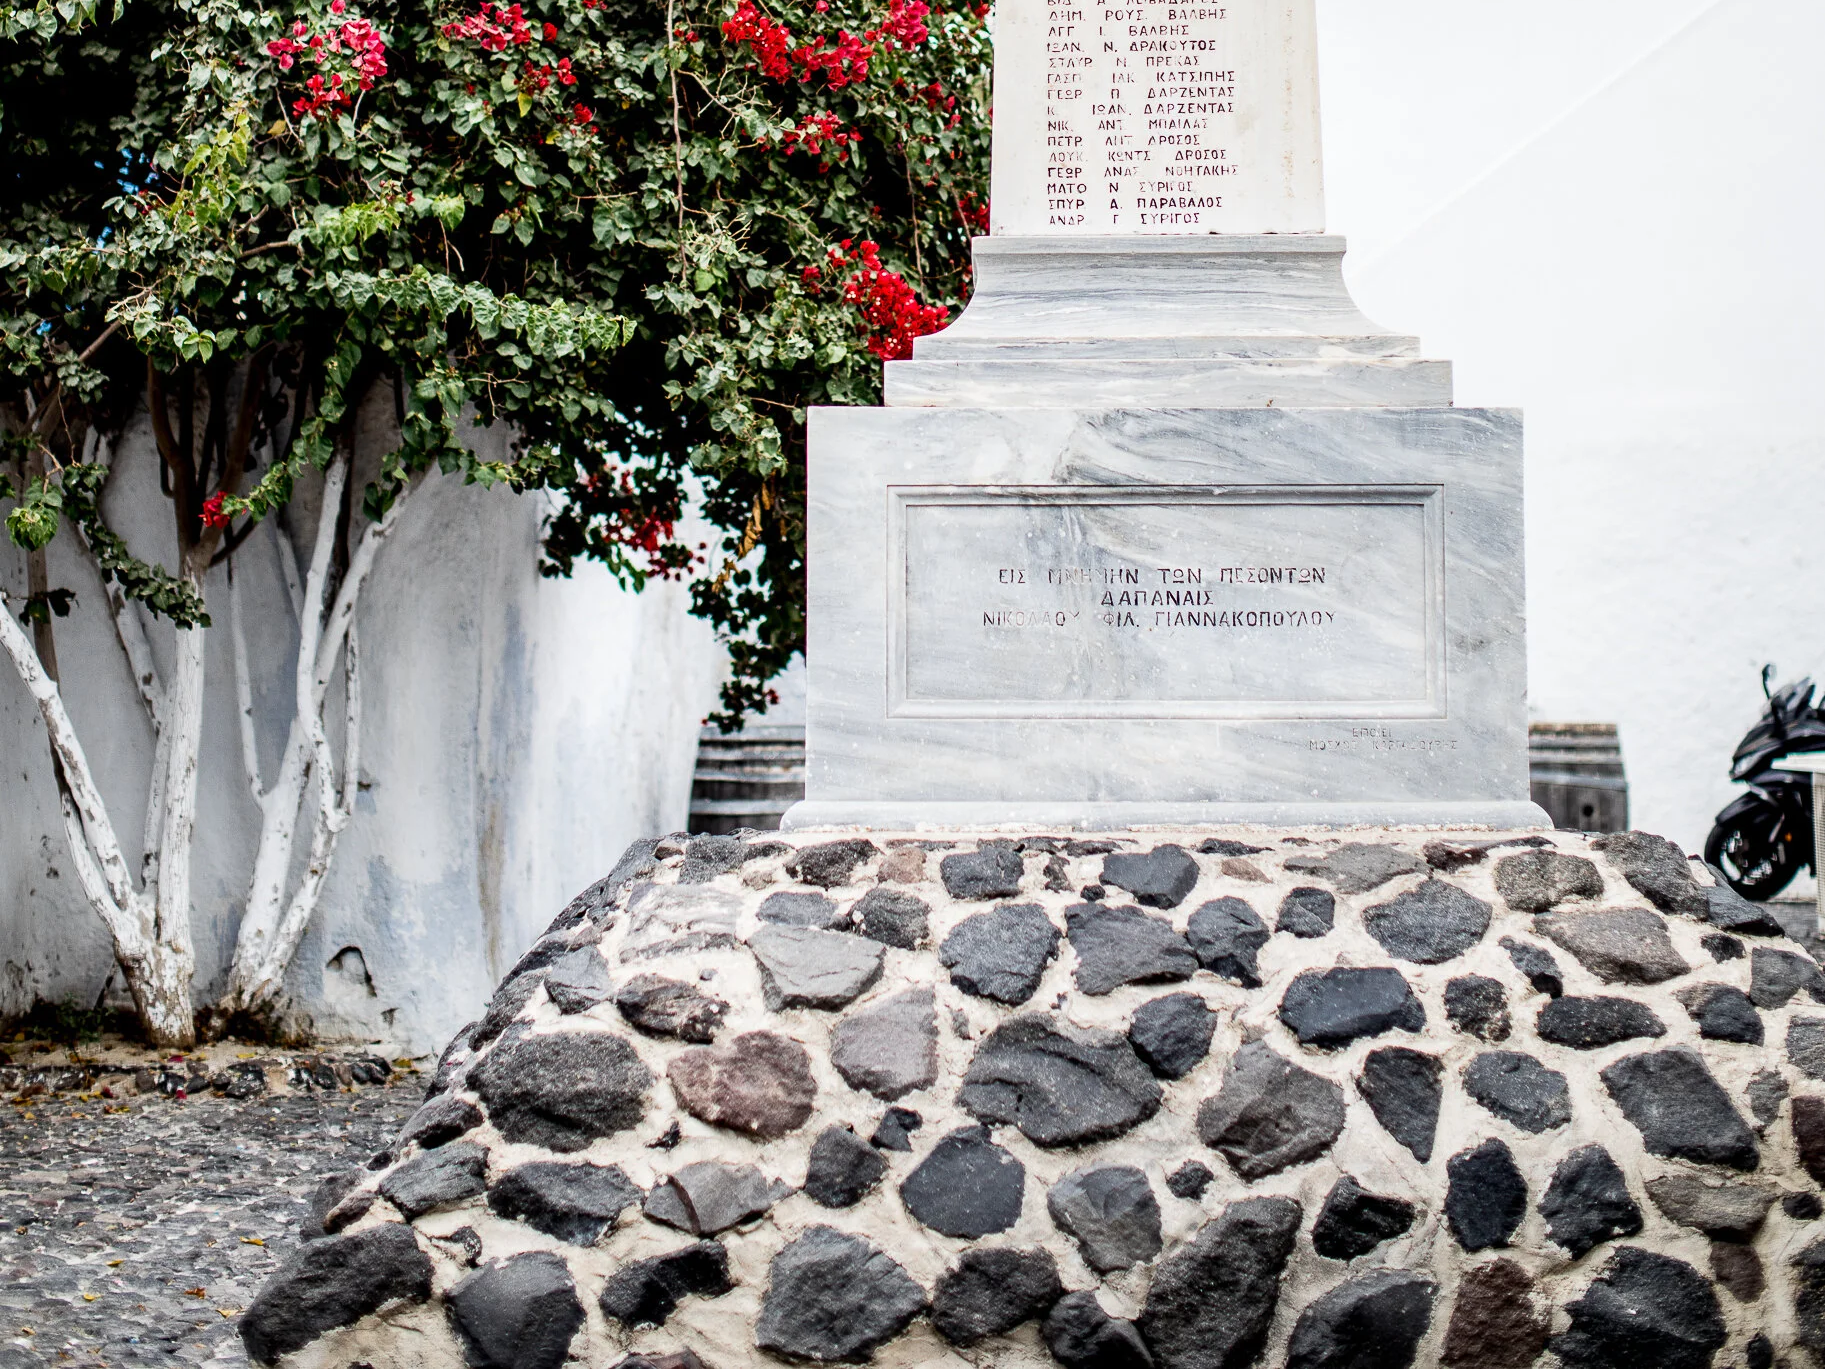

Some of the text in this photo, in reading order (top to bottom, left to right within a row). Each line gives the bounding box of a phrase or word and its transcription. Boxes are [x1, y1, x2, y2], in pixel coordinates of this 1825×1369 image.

[1049, 11, 1086, 21] ΔΗΜ.
[1169, 9, 1226, 20] ΒΑΛΒΗΣ
[1129, 25, 1189, 36] ΒΑΛΒΗΣ
[1047, 40, 1216, 53] ΙΩΑΝ. Ν. ΔΡΑΚΟΥΤΟΣ
[1146, 56, 1199, 67] ΠΡΕΚΑΣ
[1157, 71, 1234, 82] ΚΑΤΣΙΠΗΣ
[1148, 87, 1234, 98] ΔΑΡΖΕΝΤΑΣ
[1092, 104, 1131, 115] ΙΩΑΝ.
[1144, 102, 1234, 114] ΔΑΡΖΕΝΤΑΣ
[1048, 121, 1073, 132] ΝΙΚ.
[1149, 118, 1207, 129] ΜΠΑΙΛΑΣ
[1148, 135, 1200, 145] ΔΡΟΣΟΣ
[1175, 149, 1226, 161] ΔΡΟΣΟΣ
[1047, 183, 1087, 195] ΜΑΤΟ
[1139, 181, 1192, 192] ΣΥΡΙΓΟΣ
[1110, 198, 1122, 209] Α.
[1137, 197, 1222, 209] ΠΑΡΑΒΑΛΟΣ
[1141, 213, 1199, 224] ΣΥΡΙΓΟΣ
[999, 569, 1025, 584] ΕΙΣ
[1157, 568, 1201, 584] ΤΩΝ
[1221, 567, 1325, 583] ΠΕΣΟΝΤΩΝ
[1101, 590, 1213, 608] ΔΑΠΑΝΑΙΣ
[984, 610, 1334, 628] ΝΙΚΟΛΑΟΥ ΦΙΛ. ΓΙΑΝΝΑΚΟΠΟΥΛΟΥ
